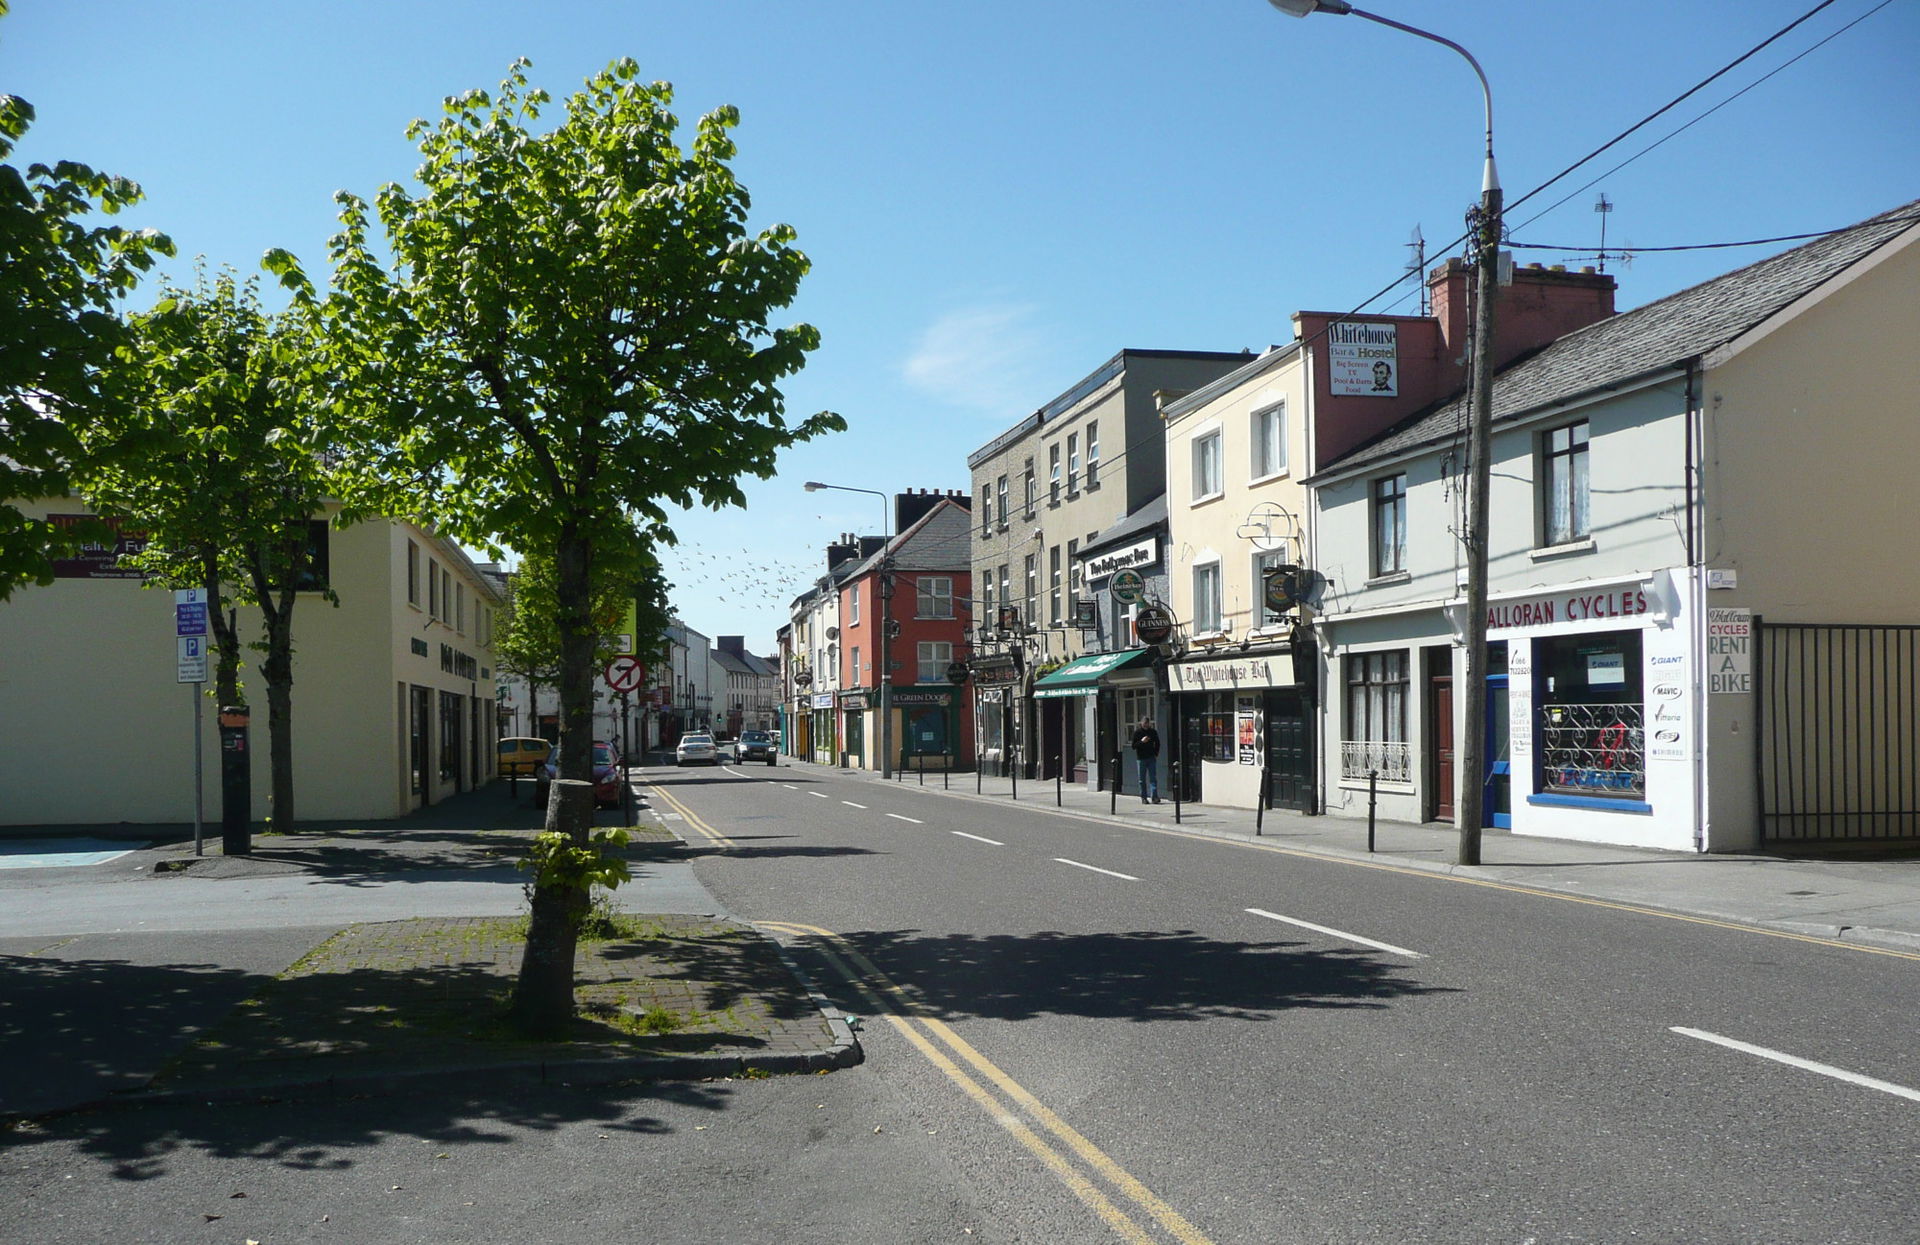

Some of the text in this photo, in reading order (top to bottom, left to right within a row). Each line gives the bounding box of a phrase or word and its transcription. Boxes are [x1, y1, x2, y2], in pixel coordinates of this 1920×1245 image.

[1330, 323, 1397, 344] Whitehouse
[1331, 347, 1396, 359] Bar & Hostel
[1336, 361, 1369, 369] Big Screen
[1486, 591, 1647, 629] ALLORAN CYCLES
[1138, 618, 1170, 628] GUINNESS
[1709, 624, 1749, 635] CYCLES
[1709, 636, 1750, 655] RENT
[1657, 655, 1684, 665] GIANT
[1720, 655, 1736, 673] A
[1202, 664, 1248, 684] Whitehouse
[1711, 674, 1751, 693] BIKE
[1657, 687, 1679, 697] MAVIC
